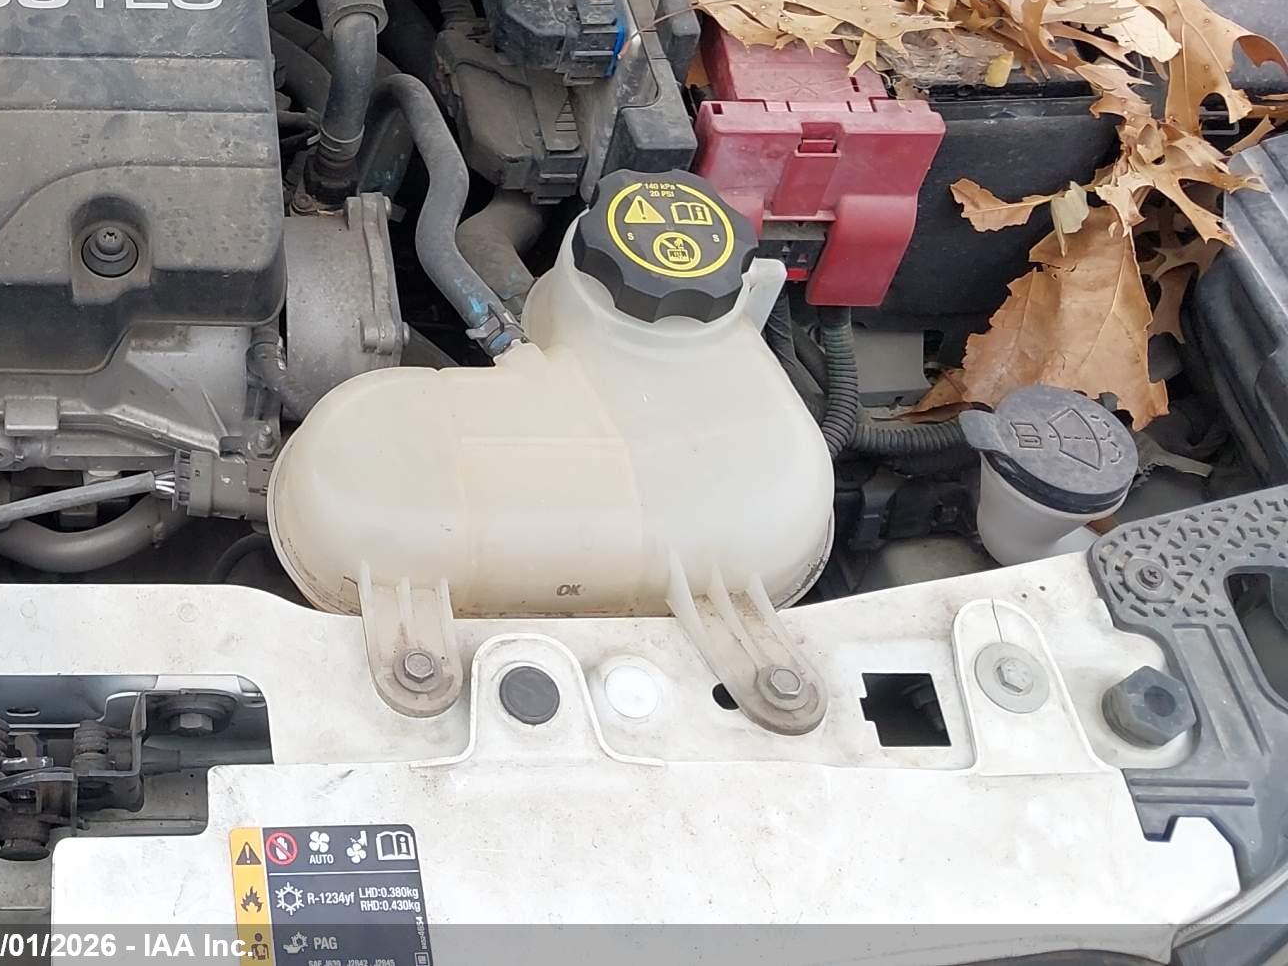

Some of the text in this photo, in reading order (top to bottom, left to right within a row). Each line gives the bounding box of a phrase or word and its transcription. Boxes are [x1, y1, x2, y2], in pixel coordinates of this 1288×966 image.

[556, 584, 582, 596] OK
[309, 854, 334, 865] AUTO
[307, 891, 355, 907] R-1234yf
[358, 887, 419, 901] LHD:0.380kg
[360, 900, 421, 913] RHD:0.430kg
[313, 937, 338, 950] PAG
